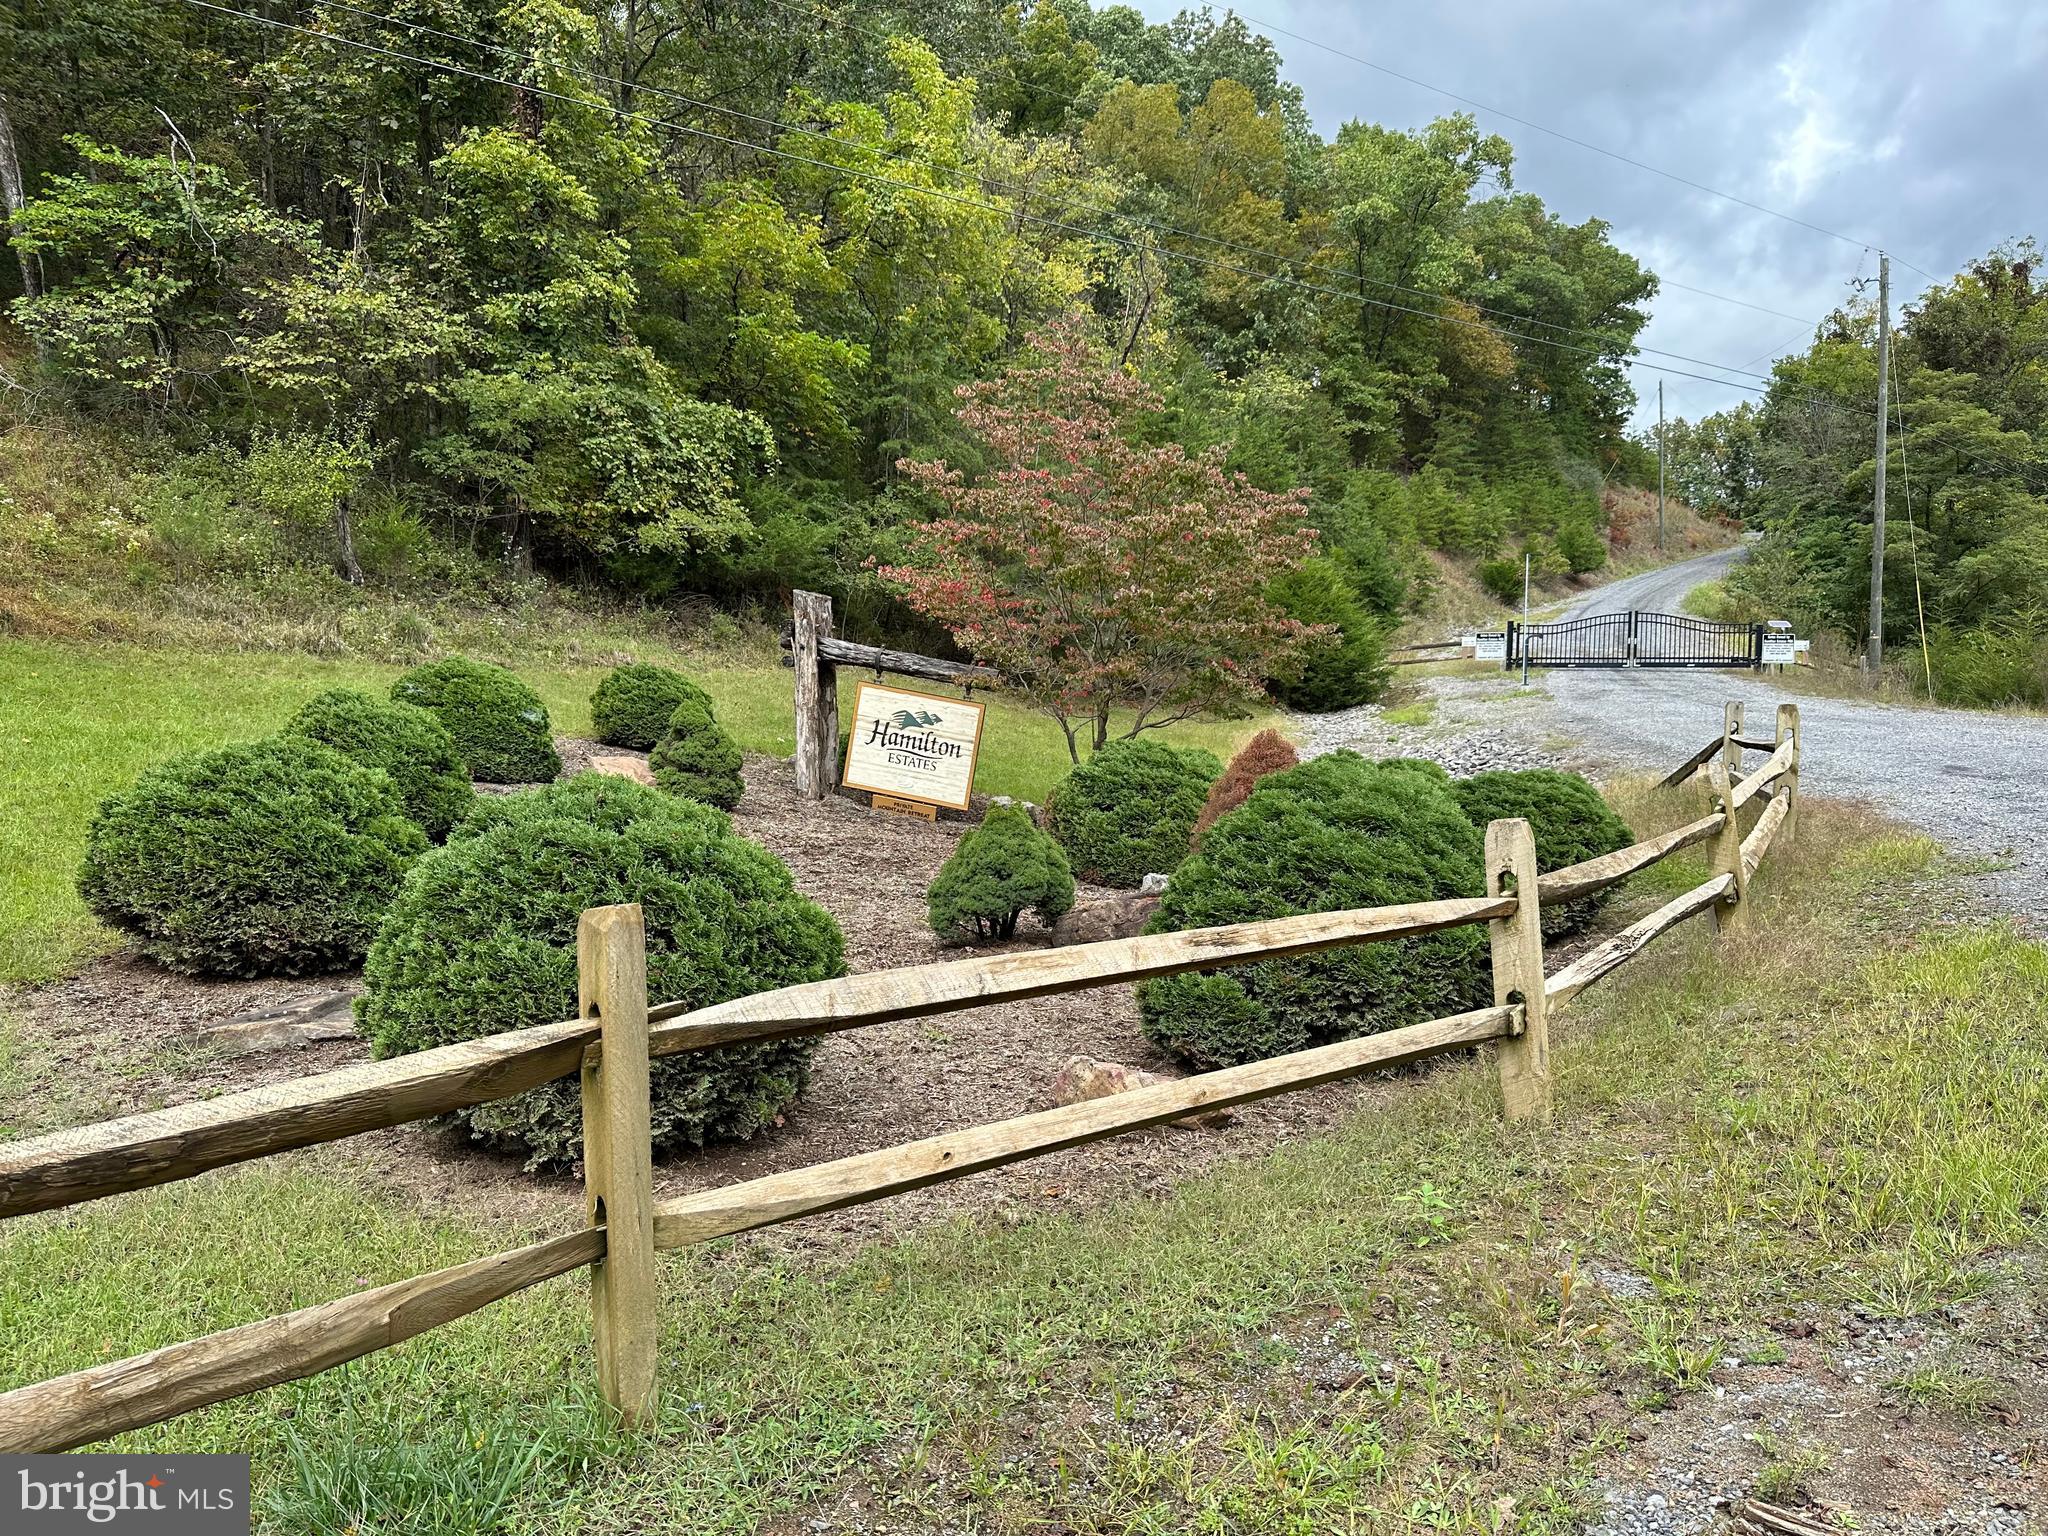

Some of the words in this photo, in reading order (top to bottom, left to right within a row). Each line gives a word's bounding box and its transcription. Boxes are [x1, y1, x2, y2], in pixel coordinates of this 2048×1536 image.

[865, 719, 963, 759] Hamilton
[888, 753, 937, 771] ESTATES
[877, 804, 906, 814] MOUNTAIN
[908, 809, 930, 818] RETREAT
[893, 802, 913, 810] PRIVATE
